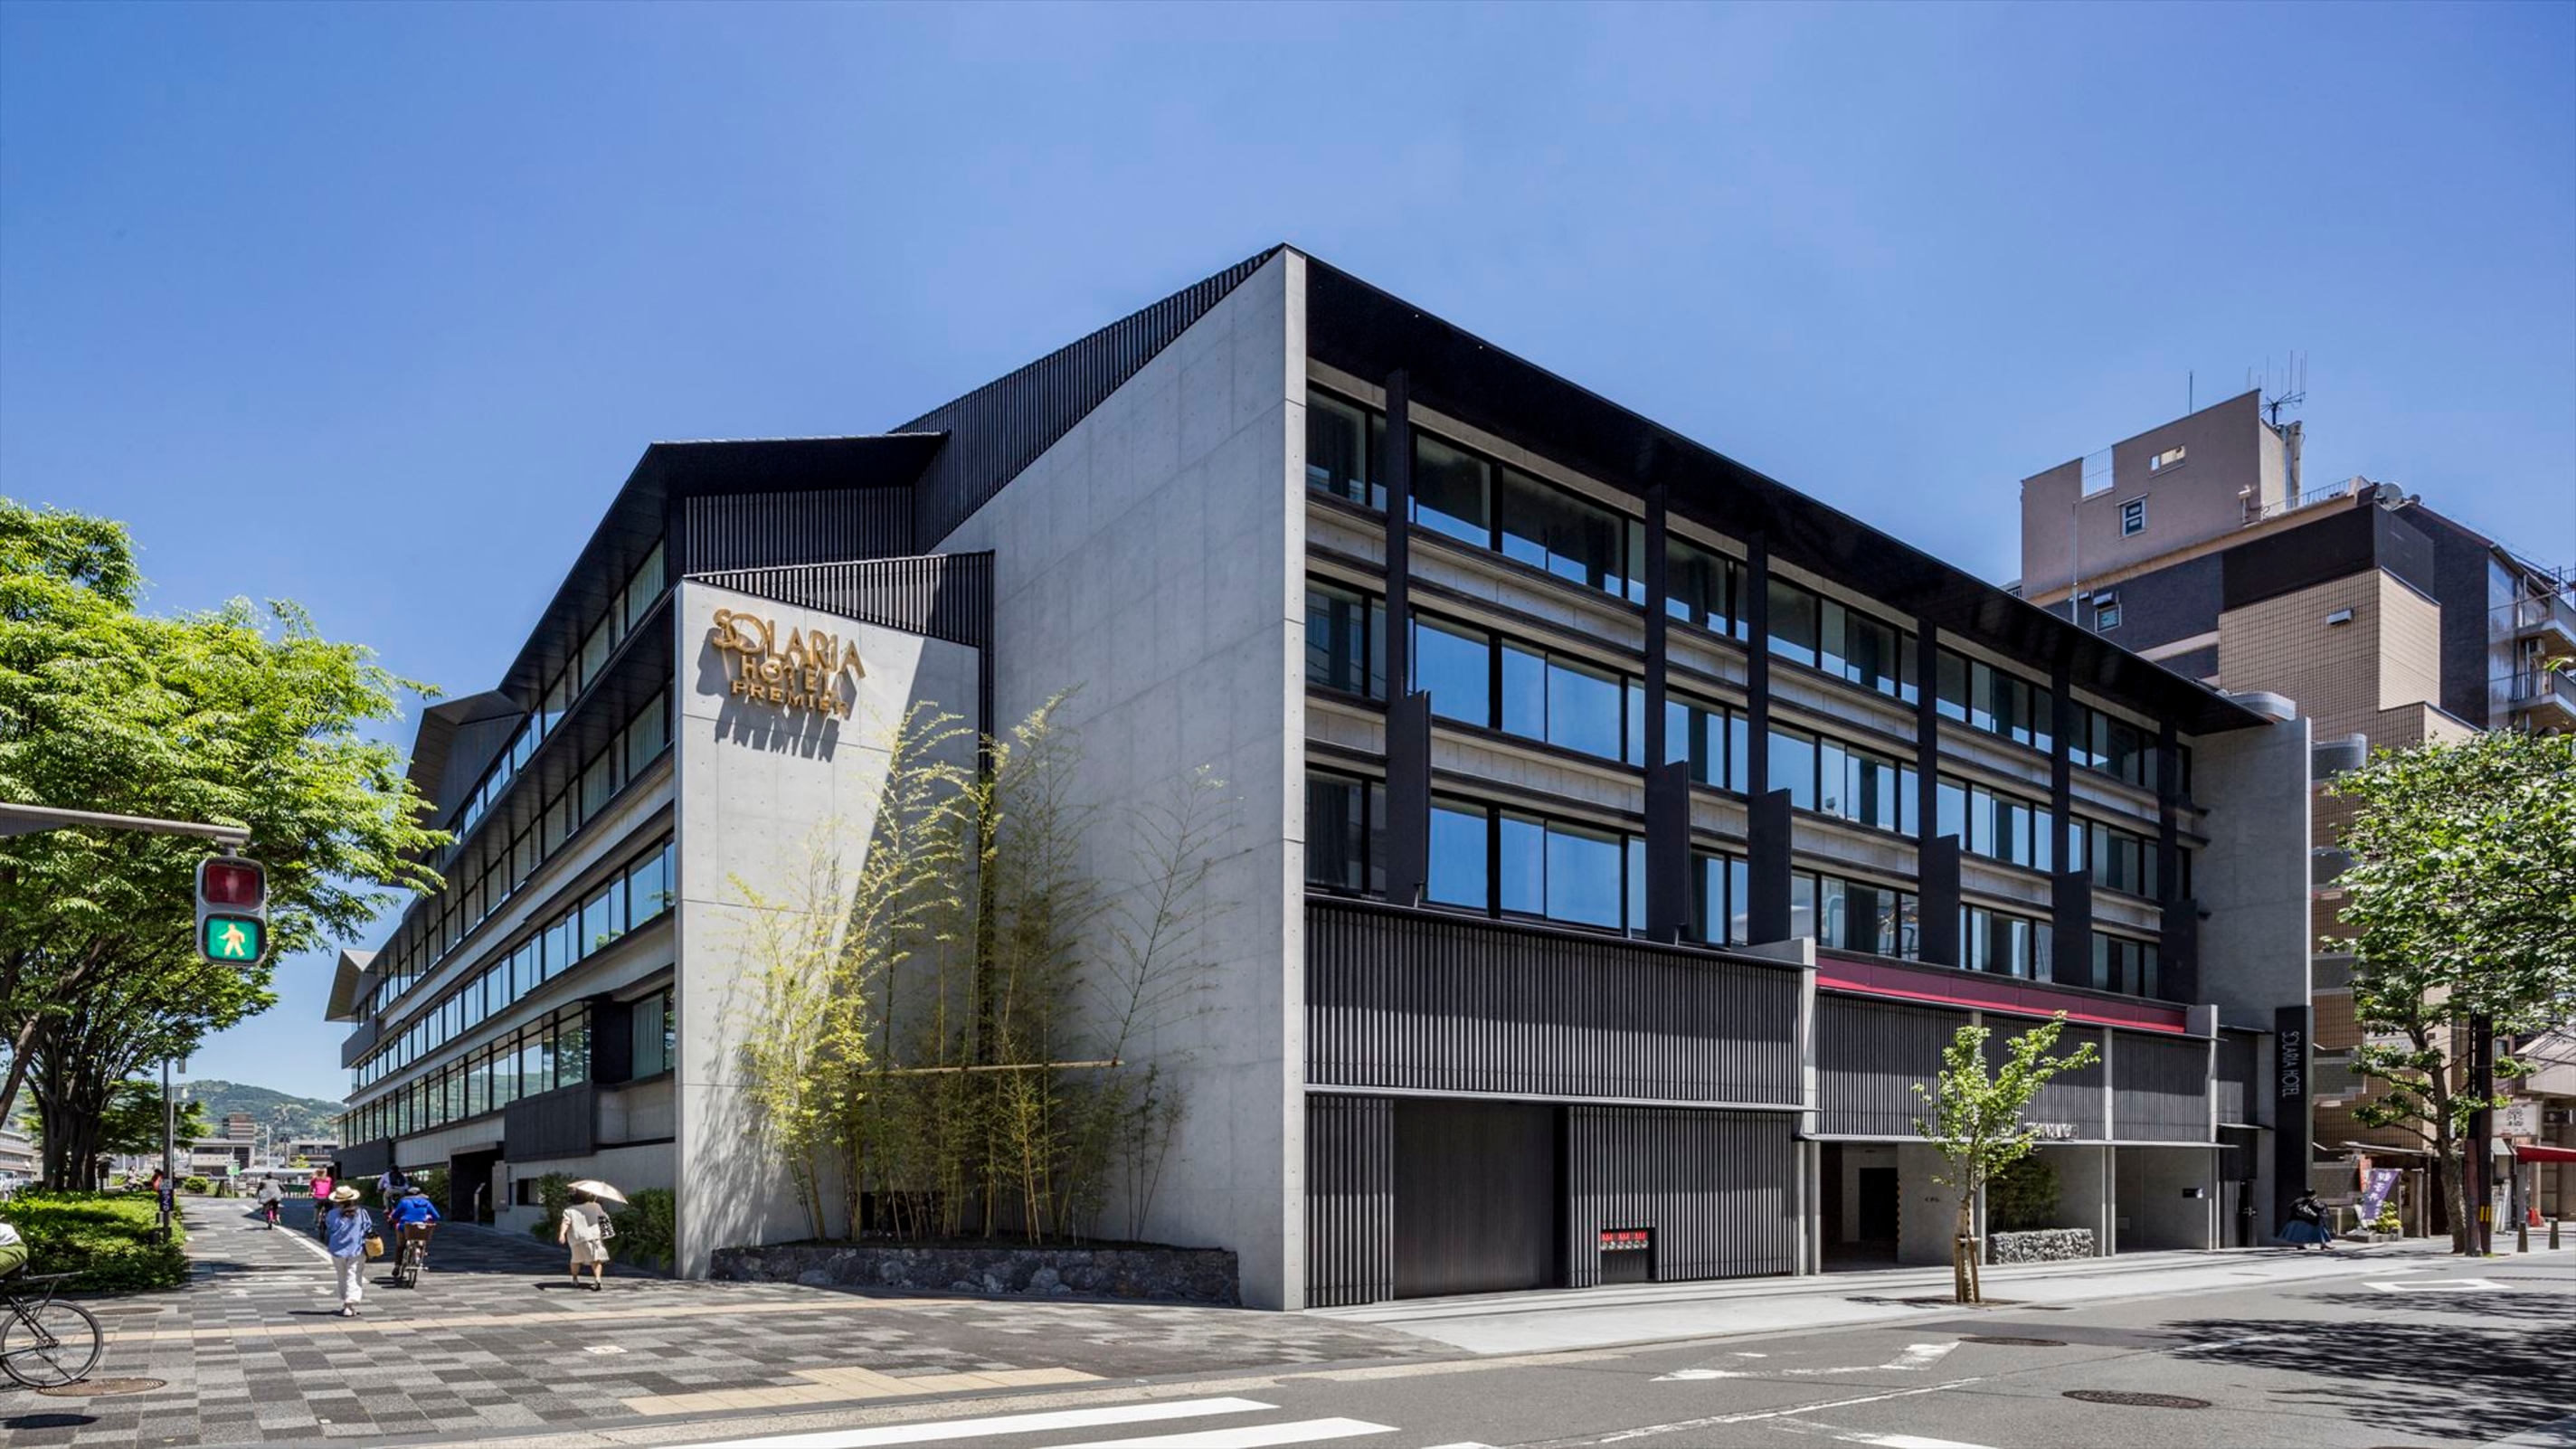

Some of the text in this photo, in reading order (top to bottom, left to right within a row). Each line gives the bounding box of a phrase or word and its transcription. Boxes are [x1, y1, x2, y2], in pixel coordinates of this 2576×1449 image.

[713, 609, 866, 678] SOLARIA
[732, 680, 849, 717] PREMIER
[741, 654, 836, 696] HOTEL
[2282, 1031, 2299, 1098] SOLARIA HOTEL
